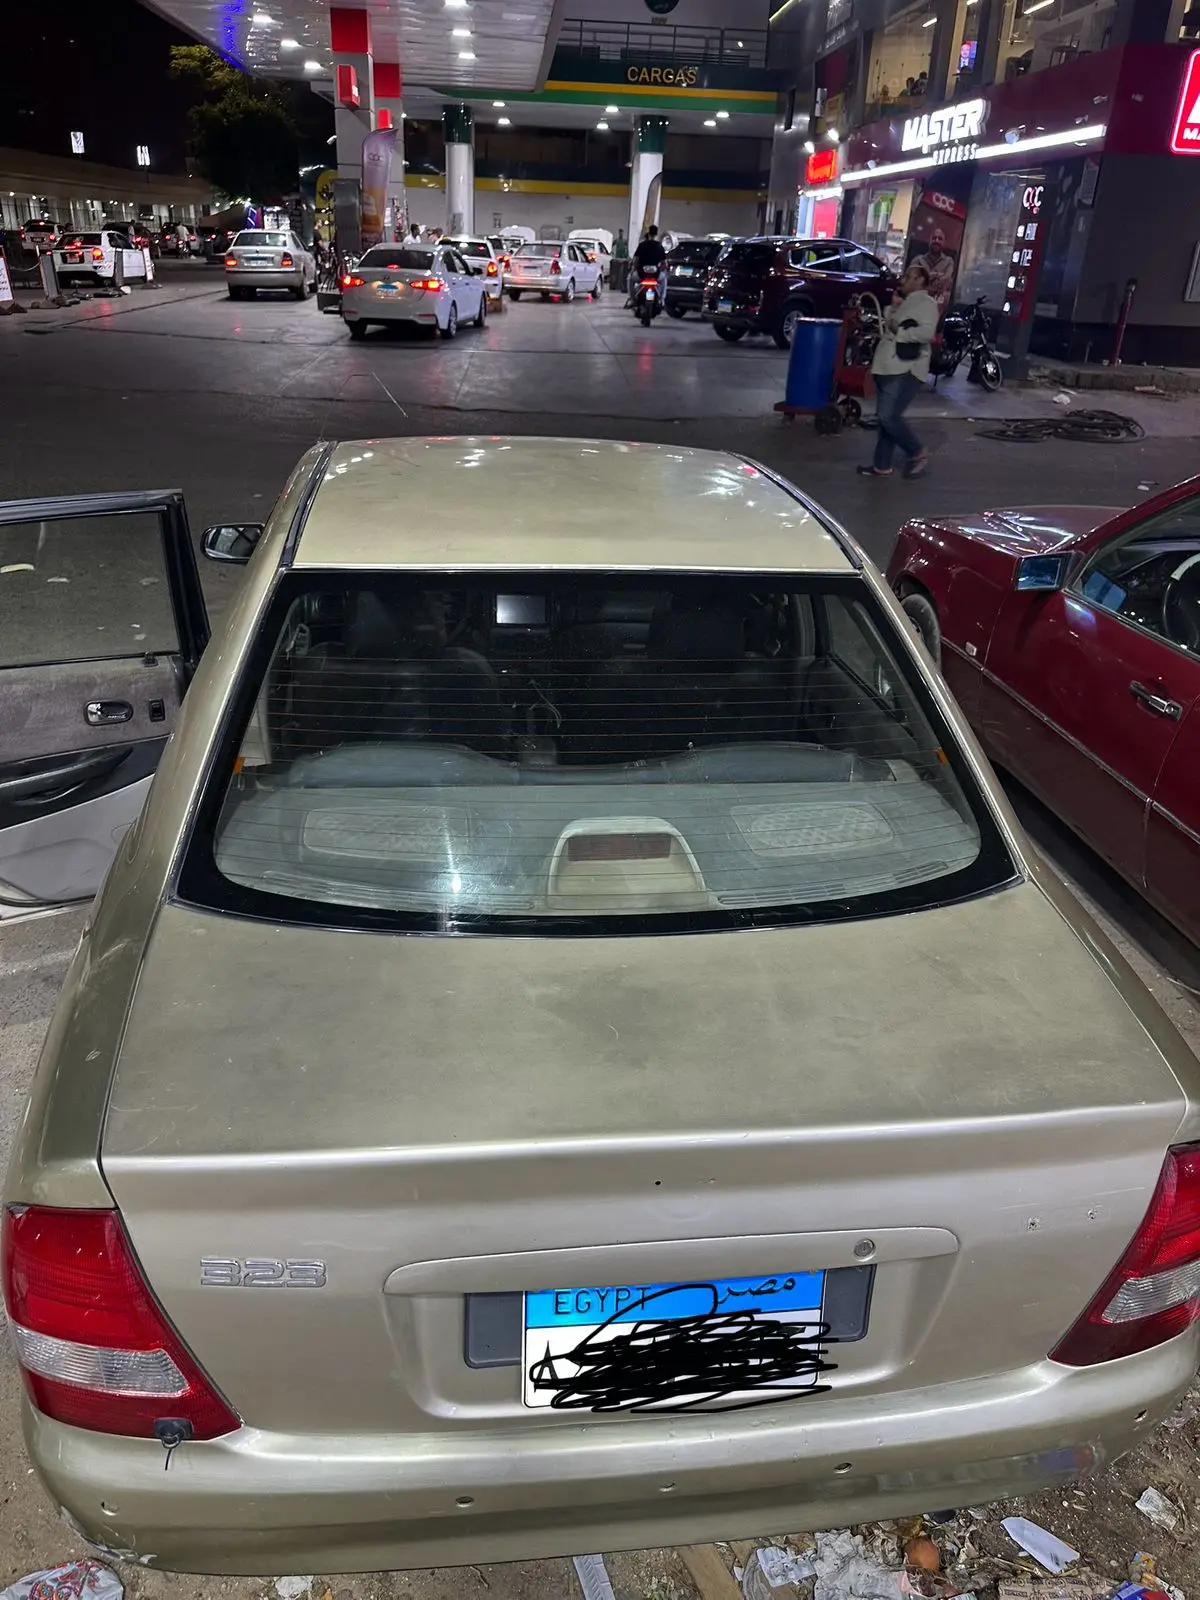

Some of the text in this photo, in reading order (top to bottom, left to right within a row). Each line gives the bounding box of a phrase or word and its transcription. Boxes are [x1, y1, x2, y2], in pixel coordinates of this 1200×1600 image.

[627, 66, 697, 85] CARGAS
[901, 98, 987, 154] MASTER
[200, 1257, 327, 1288] 323
[553, 1287, 652, 1315] EGYPT
[718, 1276, 797, 1305] مصر
